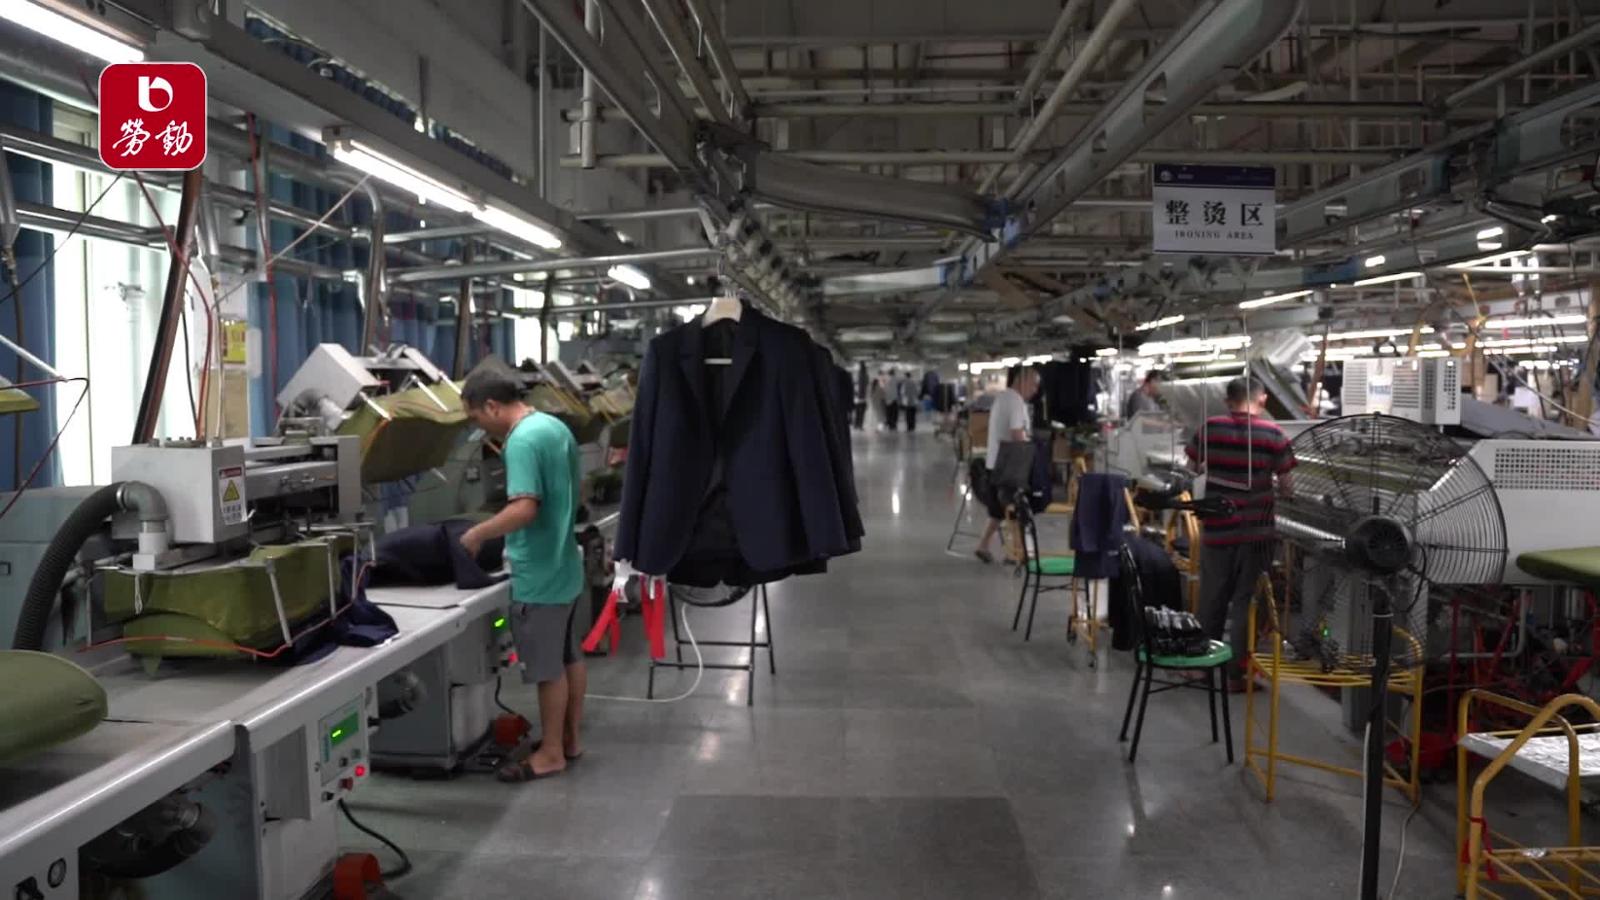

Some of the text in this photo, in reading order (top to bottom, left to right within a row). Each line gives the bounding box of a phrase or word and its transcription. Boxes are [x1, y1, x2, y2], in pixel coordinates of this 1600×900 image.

[1166, 200, 1263, 226] 整烫区
[1175, 230, 1254, 240] IRONING AREA
